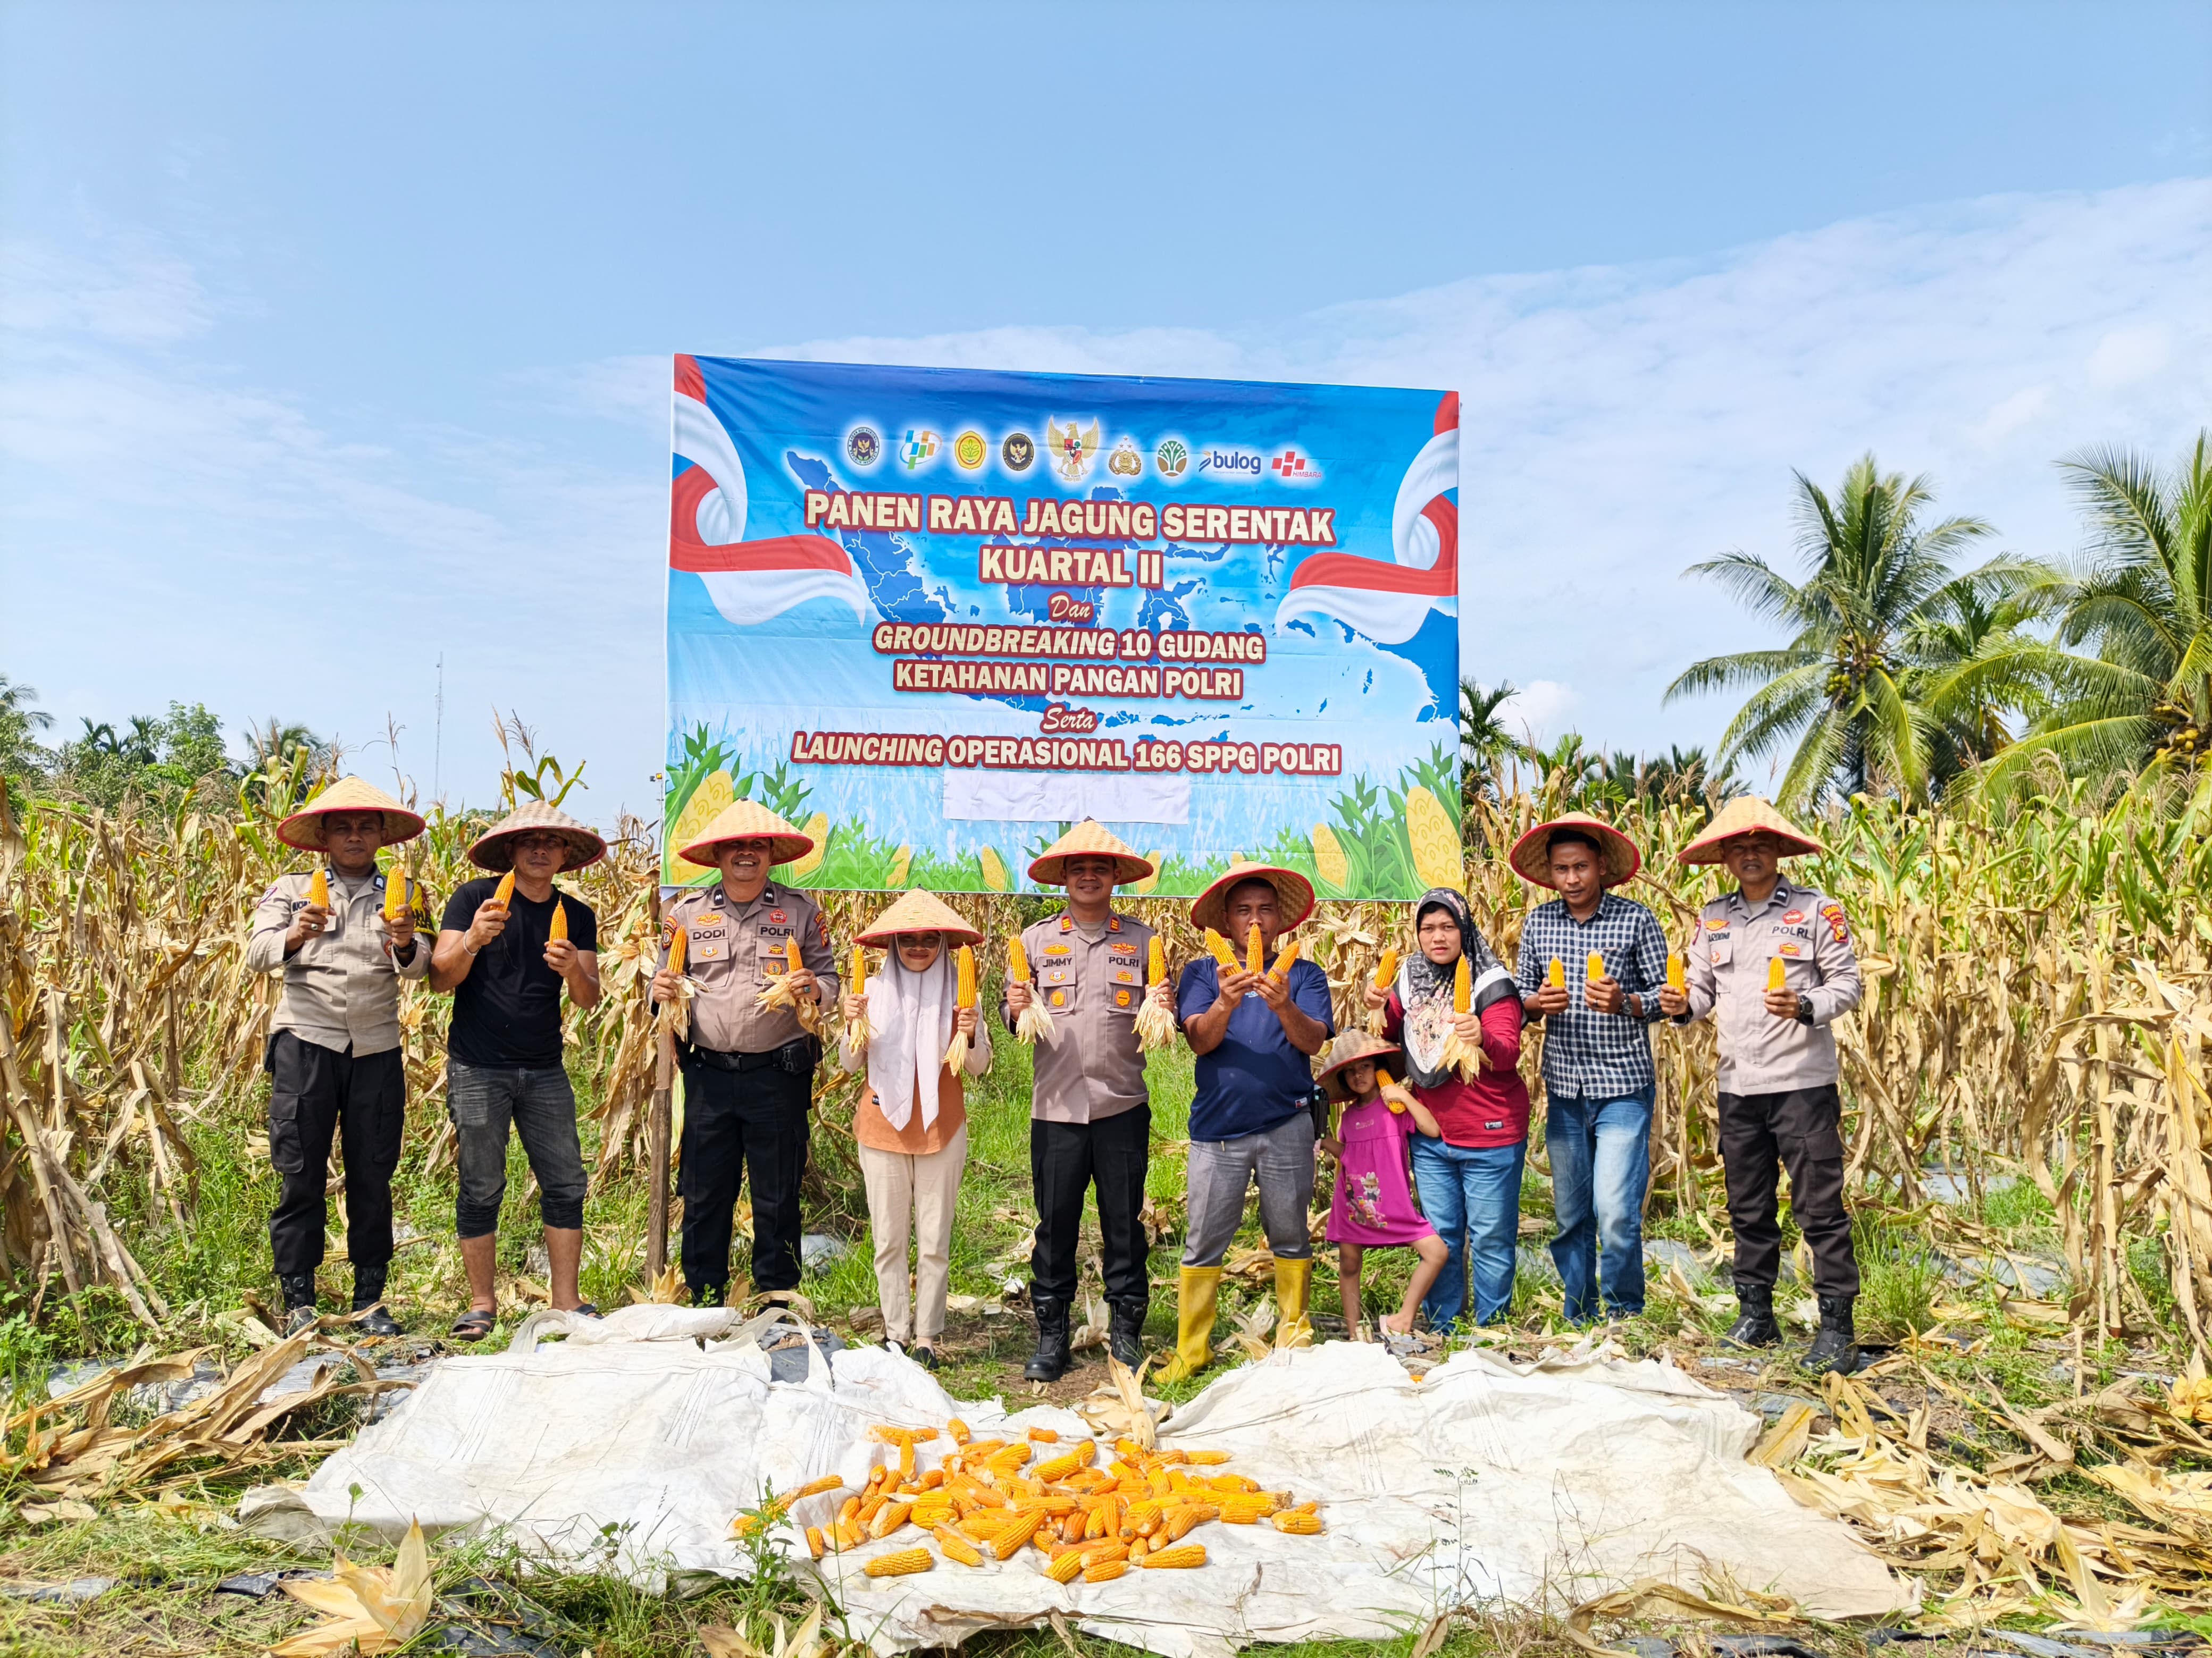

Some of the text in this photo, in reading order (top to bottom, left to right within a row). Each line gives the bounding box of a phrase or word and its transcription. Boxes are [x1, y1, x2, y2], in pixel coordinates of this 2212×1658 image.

[1213, 450, 1261, 475] bulog
[808, 493, 1333, 542] PANEN RAYA JAGUNG SERENTAK
[982, 548, 1160, 584] KUARTAL II
[1051, 595, 1090, 618] Dan
[875, 625, 1263, 660] GROUNDBREAKING 10 GUDANG
[896, 663, 1240, 695] KETAHANAN PANGAN POLRI
[1043, 708, 1094, 730] Serta
[794, 735, 1338, 771] LAUNCHING OPERASIONAL 166 SPPG POLRI
[693, 929, 725, 940] DODI
[760, 927, 794, 936] POLRI
[1772, 926, 1808, 938] POLRI
[1042, 957, 1073, 967] JIMMY
[1109, 956, 1139, 967] POLRI
